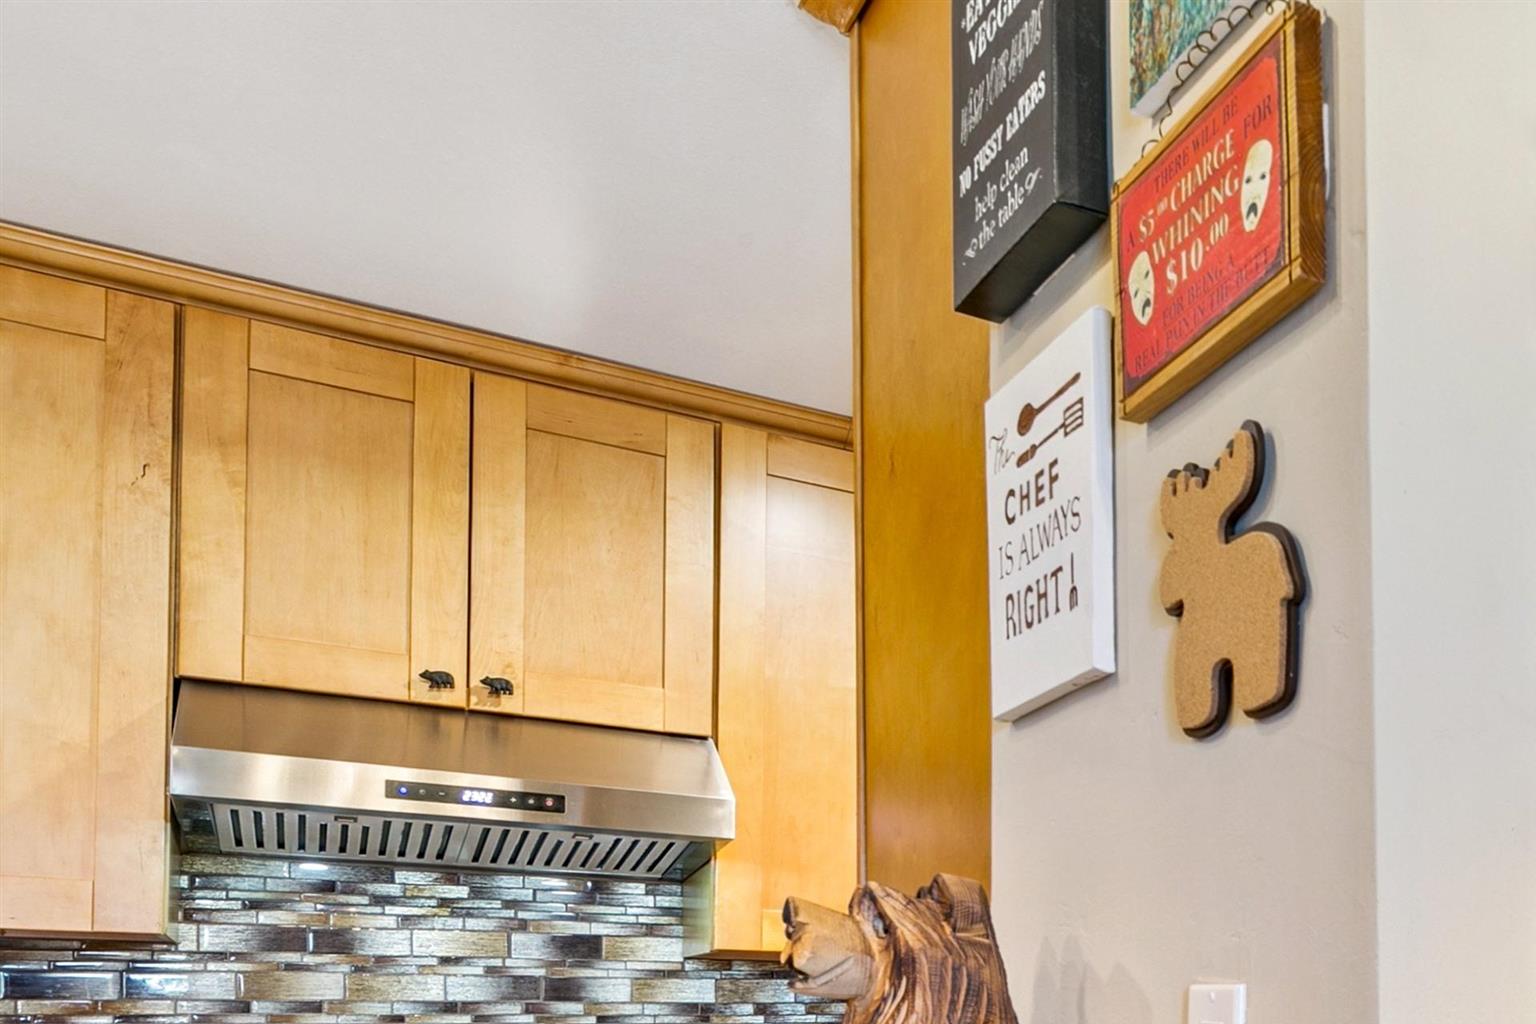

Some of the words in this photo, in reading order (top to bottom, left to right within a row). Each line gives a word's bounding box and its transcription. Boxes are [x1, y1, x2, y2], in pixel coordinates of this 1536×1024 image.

[966, 0, 990, 33] EA
[969, 0, 1020, 65] VEGG
[959, 165, 972, 198] NO
[973, 123, 1004, 181] FUSSY
[1005, 69, 1046, 142] EATERS
[1127, 231, 1135, 252] A
[1170, 128, 1235, 211] CHARGE
[1243, 94, 1273, 139] FOR
[1153, 147, 1189, 192] THERE
[1191, 119, 1219, 151] WILL
[1222, 96, 1239, 125] BE
[975, 181, 998, 223] help
[1000, 146, 1029, 192] clean
[979, 219, 996, 250] the
[998, 182, 1025, 228] table
[1152, 165, 1240, 264] WHINING
[1162, 295, 1184, 326] FOR
[1187, 266, 1223, 308] BEING
[1227, 253, 1236, 271] A
[1166, 212, 1229, 295] $10.00
[1134, 338, 1161, 372] REAL
[1165, 316, 1190, 348] PAIN
[1193, 304, 1204, 329] IN
[1206, 282, 1231, 312] THE
[1235, 247, 1269, 288] BUTT
[988, 427, 1016, 476] The
[1004, 458, 1059, 525] CHEF
[998, 540, 1014, 580] IS
[1018, 496, 1081, 571] ALWAYS
